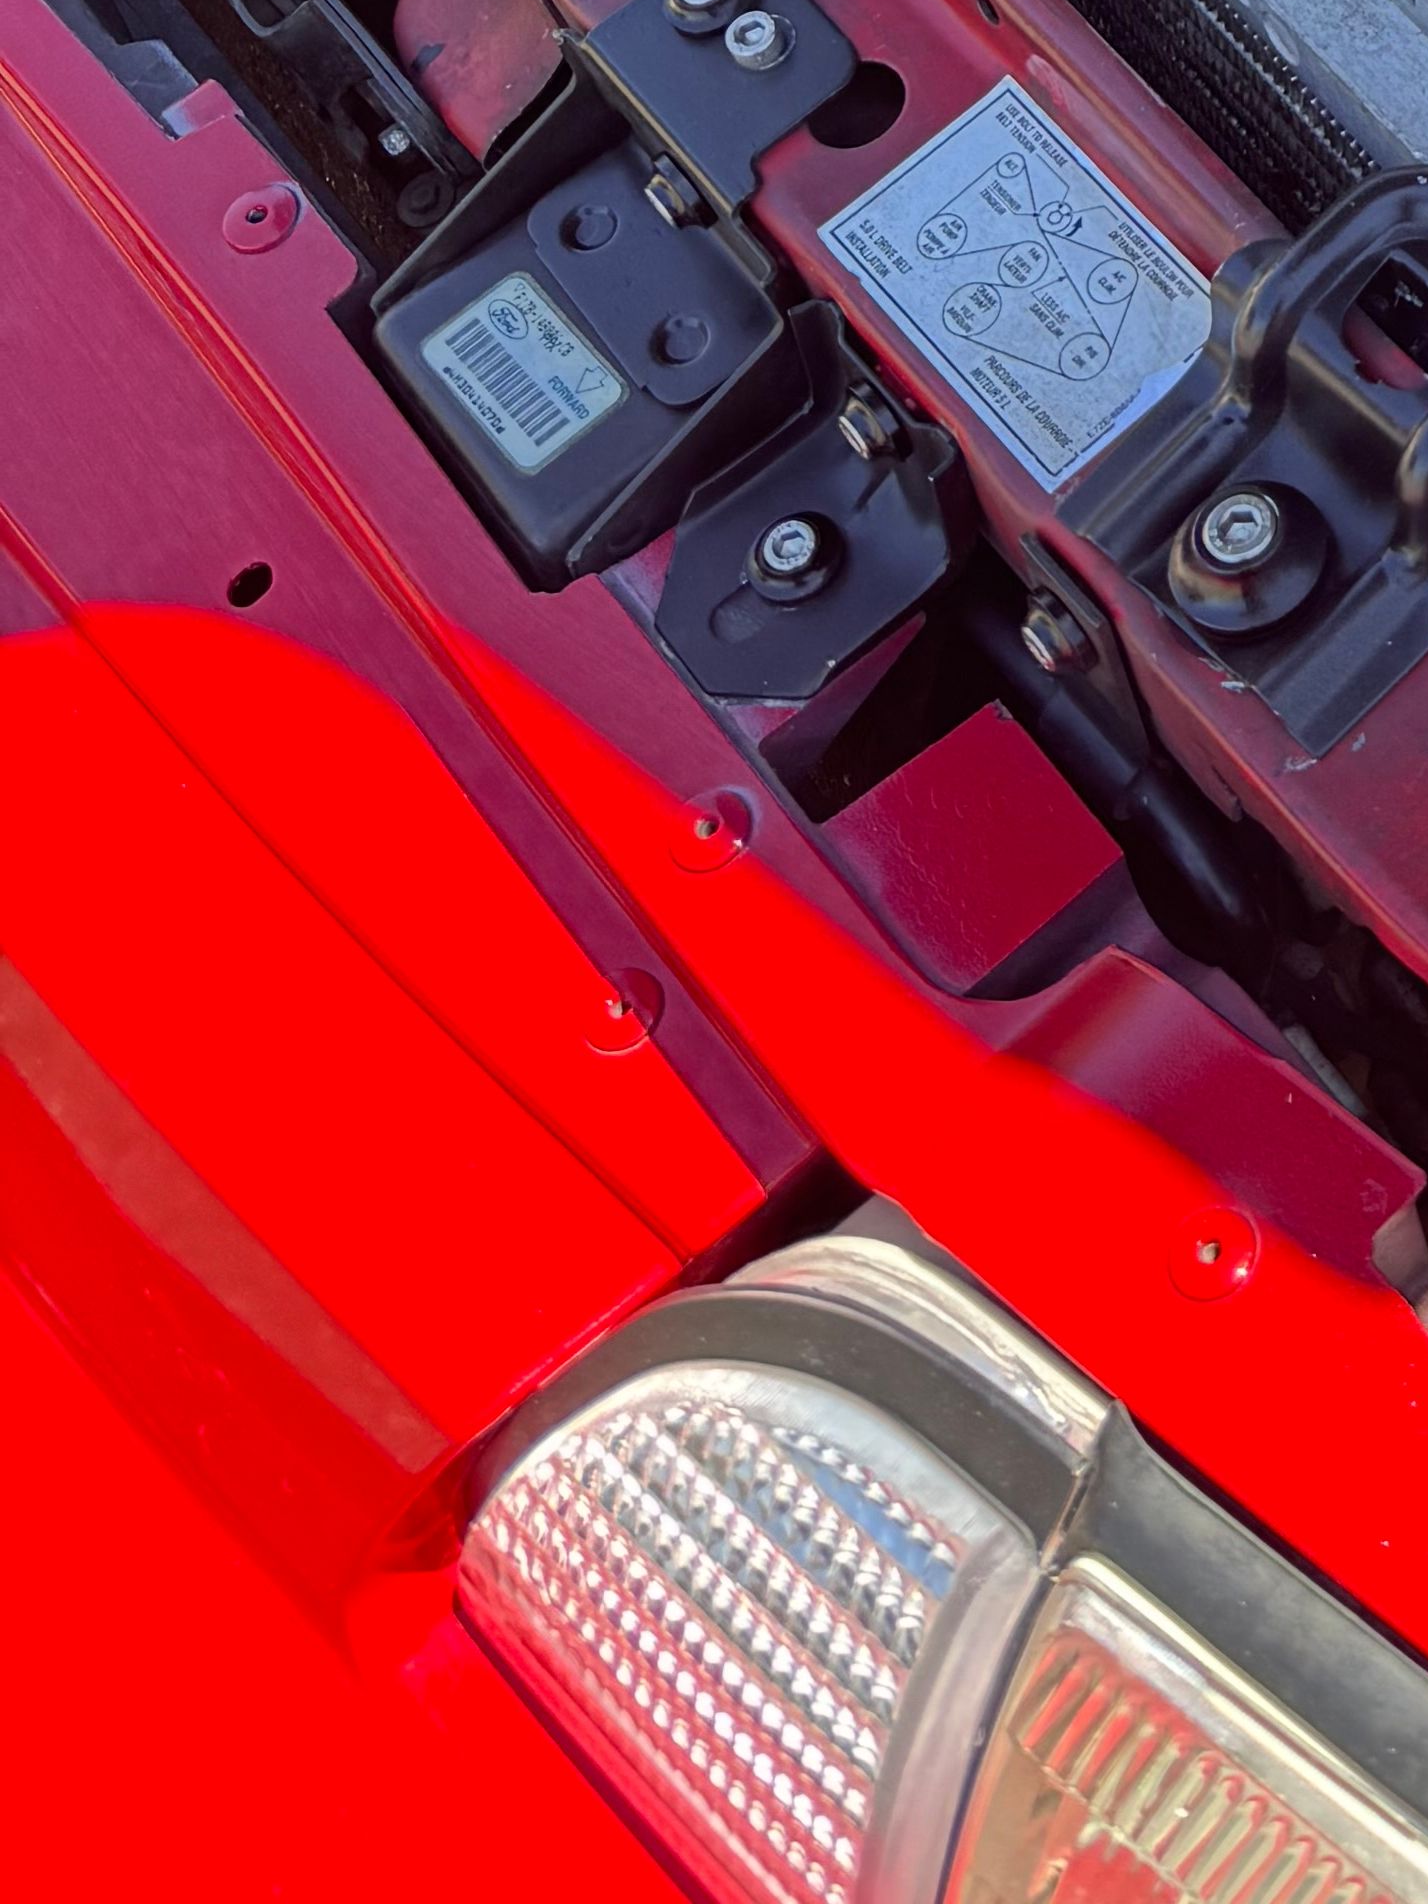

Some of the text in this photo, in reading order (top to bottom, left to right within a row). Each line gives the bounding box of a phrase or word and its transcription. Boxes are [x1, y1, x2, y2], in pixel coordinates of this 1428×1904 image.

[995, 111, 1036, 154] BELT TENSION
[1004, 103, 1068, 168] USE BOLT TO RELEASE
[843, 230, 891, 279] INSTALLATION
[873, 235, 897, 260] DRIVE
[892, 255, 913, 276] BELT
[1026, 246, 1042, 263] FAN
[1117, 220, 1148, 251] UTILISER
[1150, 253, 1178, 282] BOULON
[1173, 277, 1194, 299] POUR
[1136, 258, 1150, 272] LA
[490, 302, 524, 337] Ford
[1028, 301, 1049, 323] SANS
[1039, 292, 1059, 311] LESS
[546, 373, 591, 421] FORWARD
[968, 366, 1002, 400] MOTEUR
[982, 354, 1073, 450] PARCOURS DE LA COURROIE
